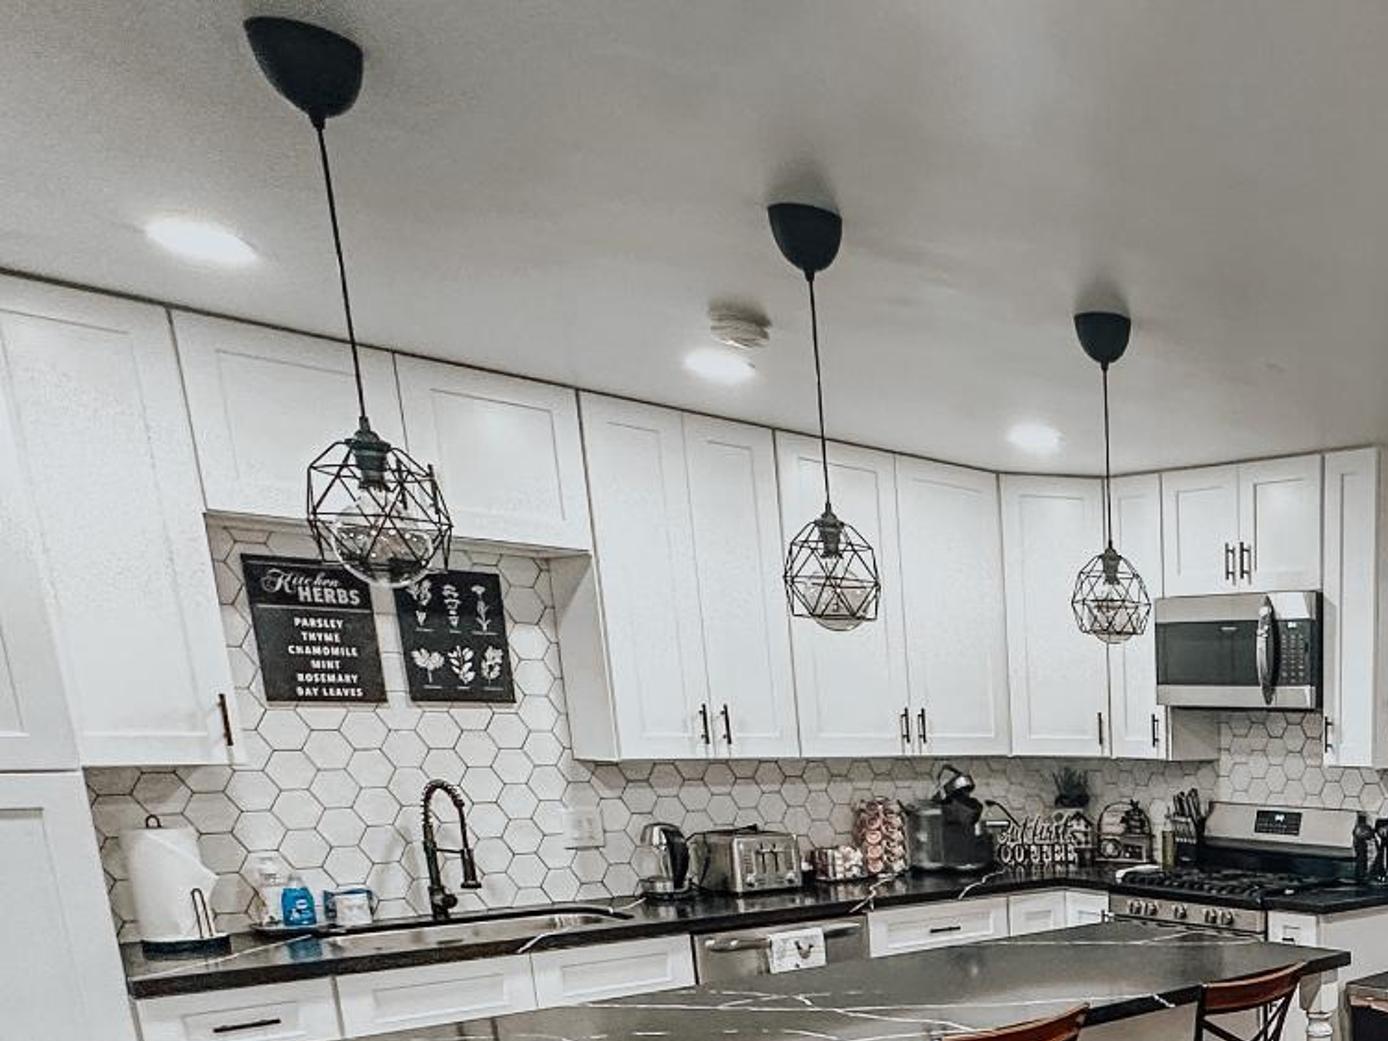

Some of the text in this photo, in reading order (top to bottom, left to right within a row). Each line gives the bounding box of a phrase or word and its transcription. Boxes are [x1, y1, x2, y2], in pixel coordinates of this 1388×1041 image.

[261, 568, 340, 592] Kitchen
[297, 586, 360, 605] HERBS
[293, 616, 344, 629] PARSLEY
[301, 631, 341, 642] THYME
[287, 645, 359, 657] CHAMOMILE
[310, 660, 341, 670] MINT
[296, 673, 358, 684] ROSEMARY
[296, 686, 364, 697] BAY LEAVES
